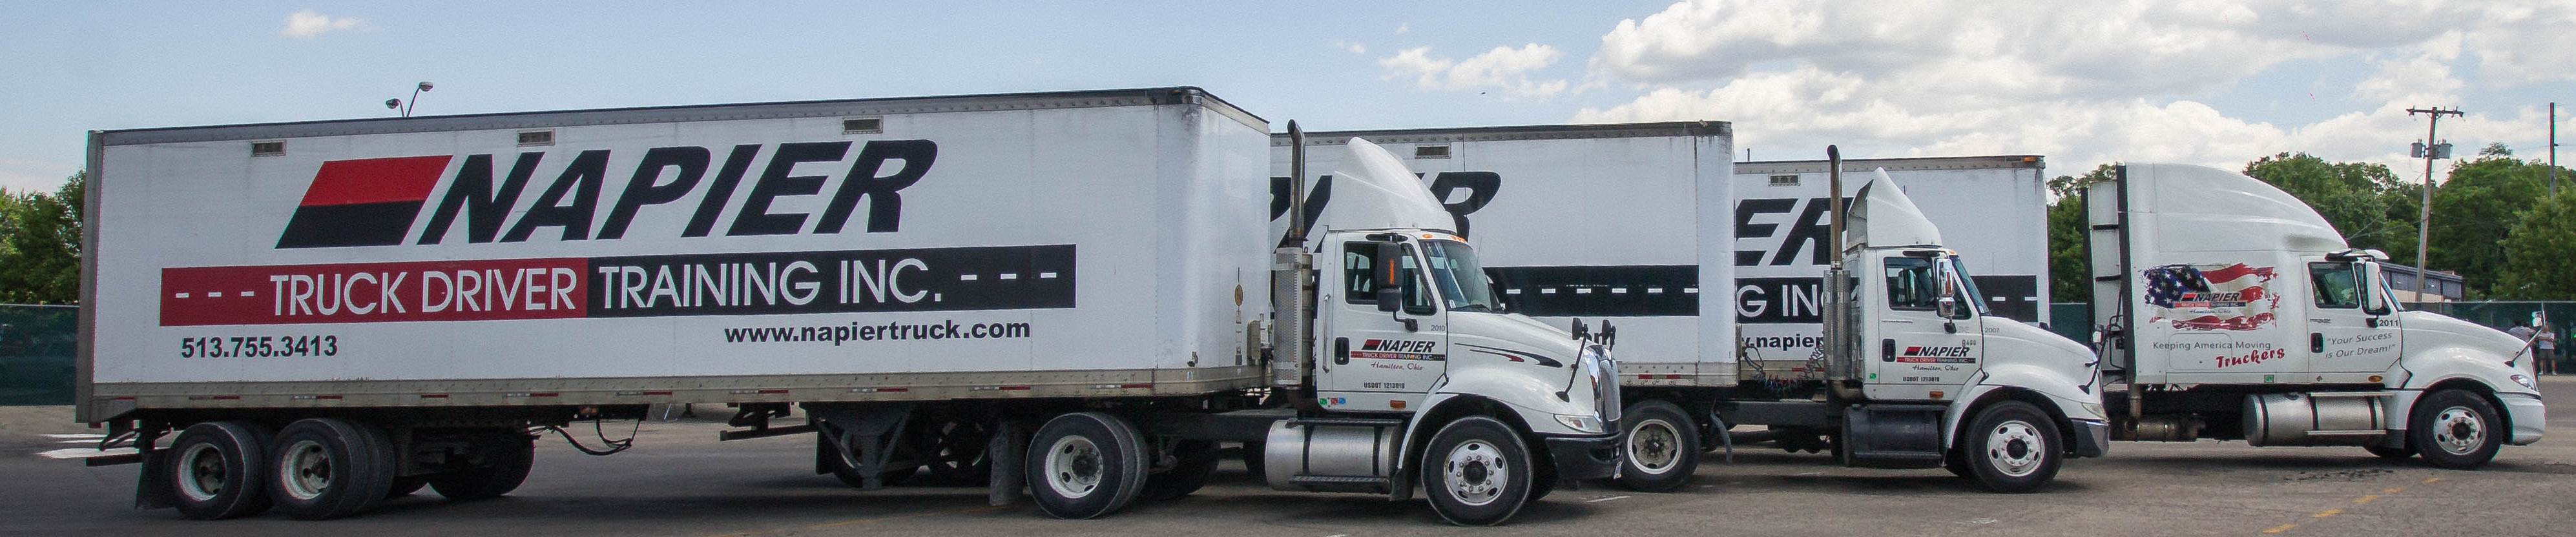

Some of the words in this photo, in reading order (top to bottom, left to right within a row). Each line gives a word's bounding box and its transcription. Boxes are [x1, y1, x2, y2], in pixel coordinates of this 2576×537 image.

[416, 139, 938, 245] NAPIER
[269, 272, 408, 316] TRUCK
[422, 267, 577, 312] DRIVER
[599, 261, 820, 309] TRAINING
[840, 258, 942, 303] INC.
[1782, 284, 1823, 316] IN
[2195, 292, 2240, 301] NAPIER
[724, 319, 1031, 346] www.napiertruck.com
[2356, 332, 2393, 342] Success
[181, 334, 338, 358] 513.755.3413
[1378, 339, 1436, 353] NAPIER
[1918, 347, 1970, 357] NAPIER
[2153, 341, 2191, 351] Keeping
[2235, 341, 2271, 350] Moving
[2216, 348, 2285, 369] Truckers
[2336, 349, 2354, 358] Our
[1407, 363, 1423, 371] Ohio
